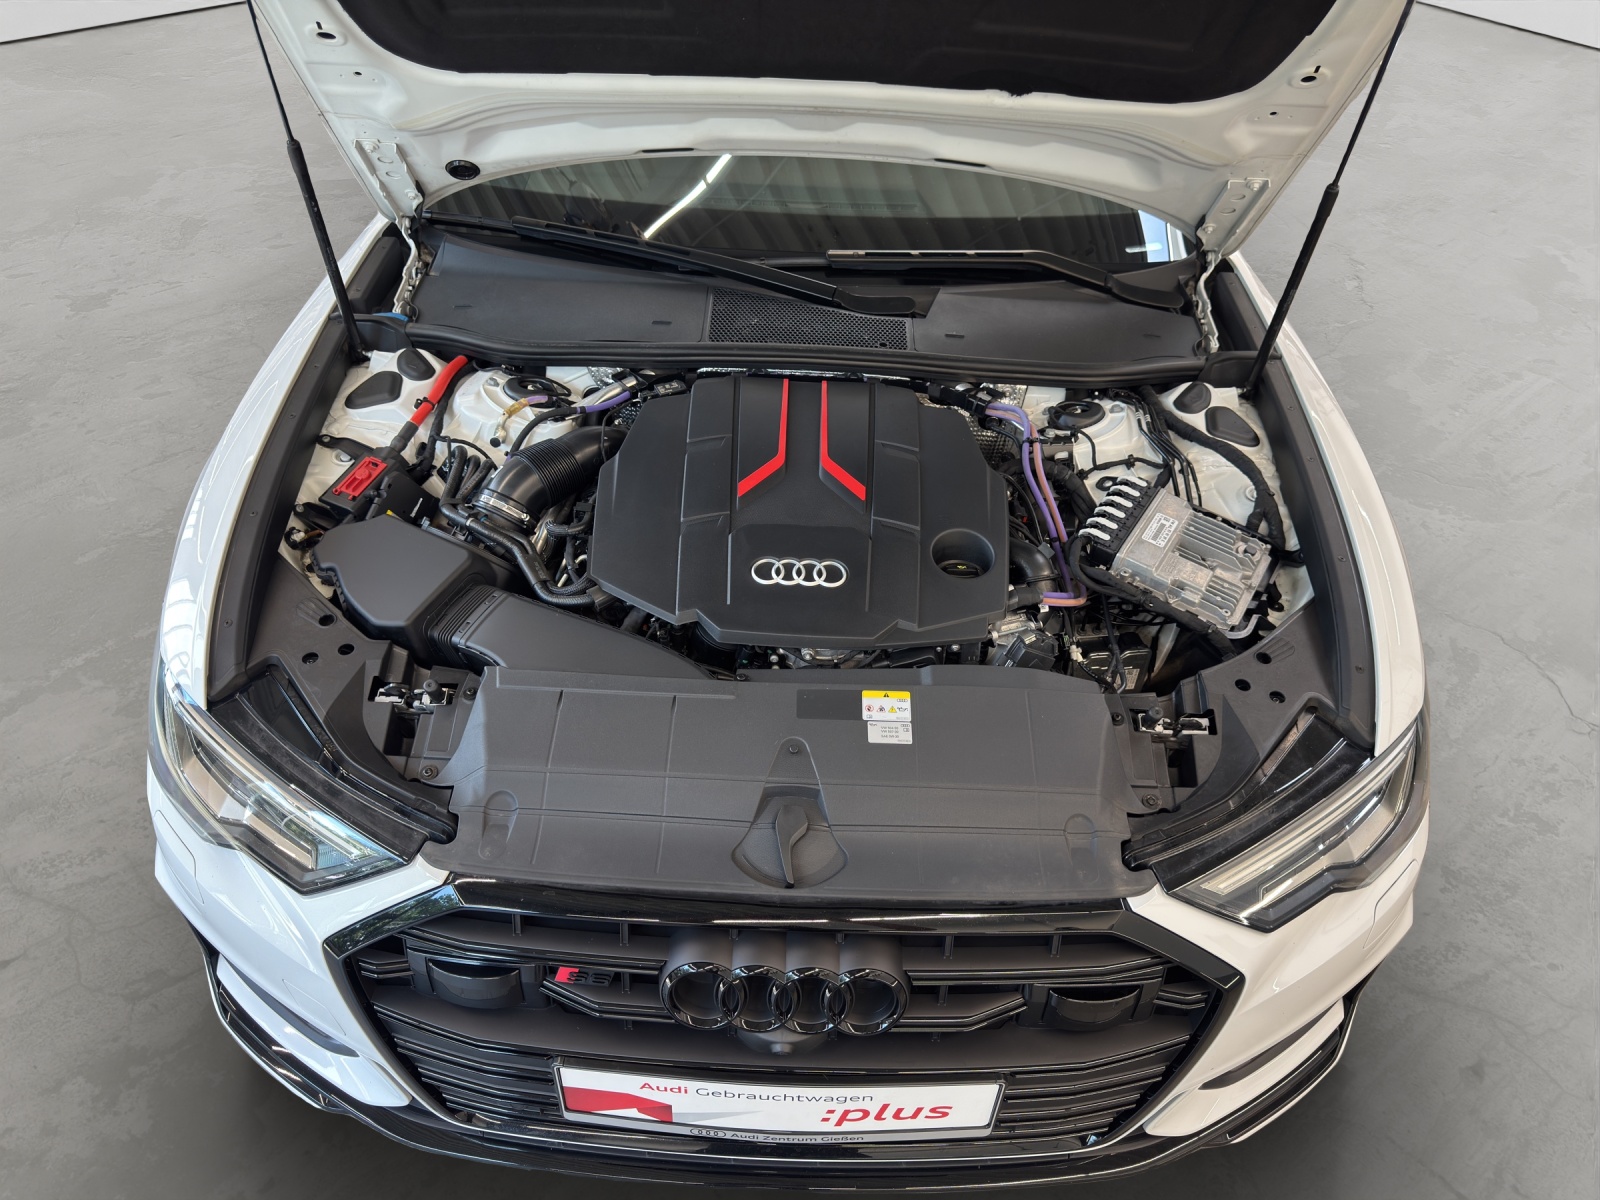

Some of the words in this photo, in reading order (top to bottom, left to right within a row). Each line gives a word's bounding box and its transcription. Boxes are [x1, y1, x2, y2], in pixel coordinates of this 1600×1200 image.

[639, 1082, 688, 1094] Audi
[695, 1088, 874, 1104] Gebrauchtwagen
[730, 1132, 759, 1140] Audi
